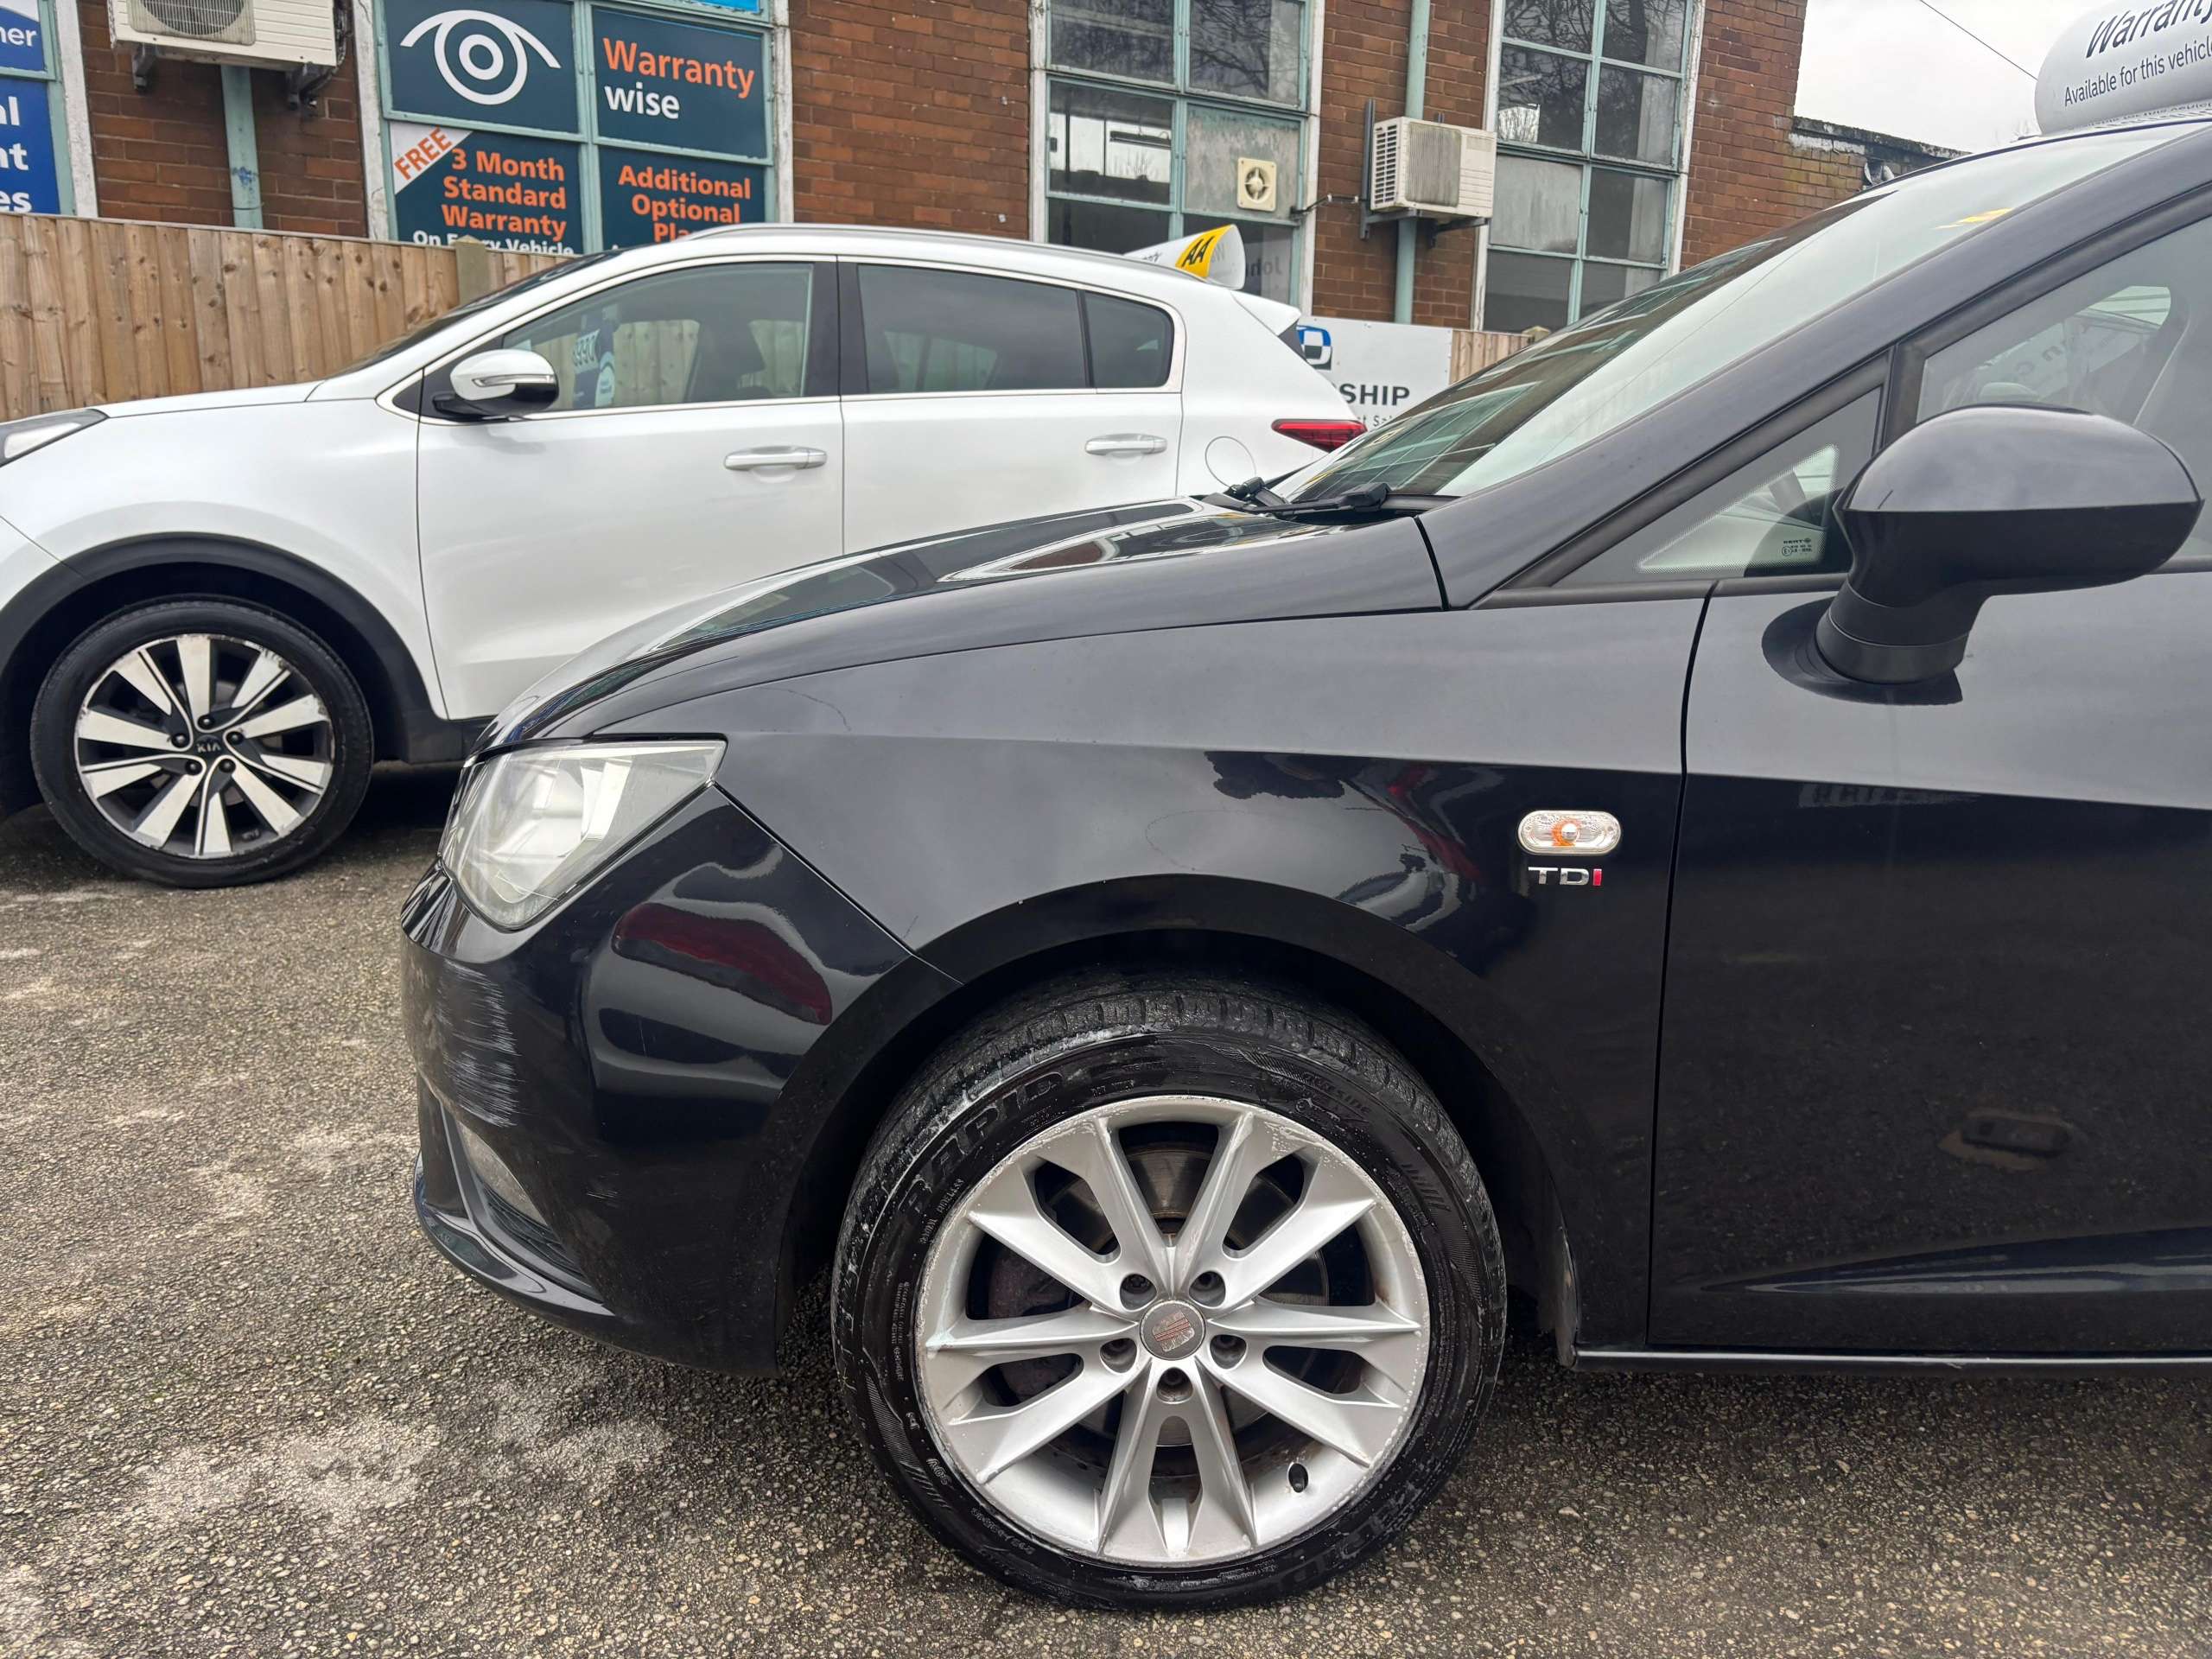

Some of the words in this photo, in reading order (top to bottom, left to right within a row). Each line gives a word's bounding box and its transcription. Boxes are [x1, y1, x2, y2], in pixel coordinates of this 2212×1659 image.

[603, 37, 754, 99] Warranty
[2064, 73, 2117, 106] Available
[2120, 66, 2138, 87] for
[2140, 54, 2165, 79] this
[2168, 35, 2212, 70] vehicl
[604, 81, 680, 119] wise
[394, 125, 452, 180] FREE
[451, 148, 467, 171] 3
[476, 150, 565, 181] Month
[443, 175, 567, 210] Standard
[618, 165, 751, 200] Additional
[442, 204, 567, 243] Warranty
[632, 194, 741, 223] Optional
[412, 230, 442, 245] On
[505, 238, 575, 255] Vehicle
[1182, 235, 1216, 267] AA
[1332, 381, 1411, 406] SHIP
[197, 742, 220, 753] KIA
